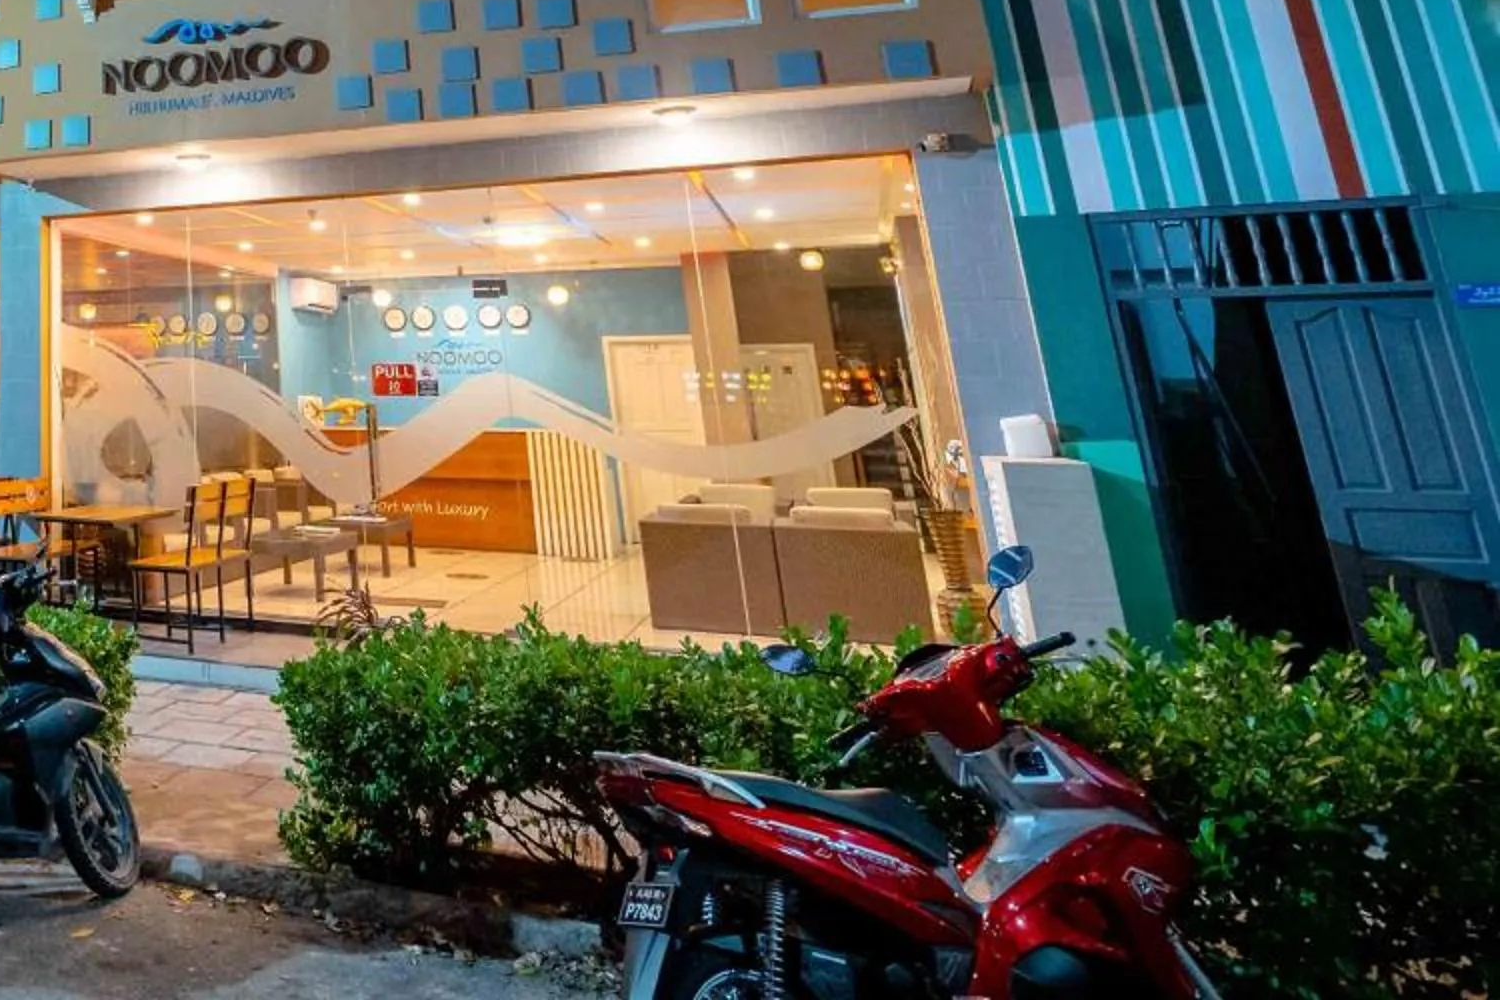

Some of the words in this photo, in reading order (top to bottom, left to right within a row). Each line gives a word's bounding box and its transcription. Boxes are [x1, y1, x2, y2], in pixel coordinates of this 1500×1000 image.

[102, 36, 330, 95] NOOMOO
[221, 86, 296, 106] MALDIVES
[416, 349, 503, 367] NOOMOO
[375, 364, 414, 379] PULL
[401, 500, 434, 514] with
[436, 501, 490, 520] Luxury
[625, 902, 663, 921] P7843
